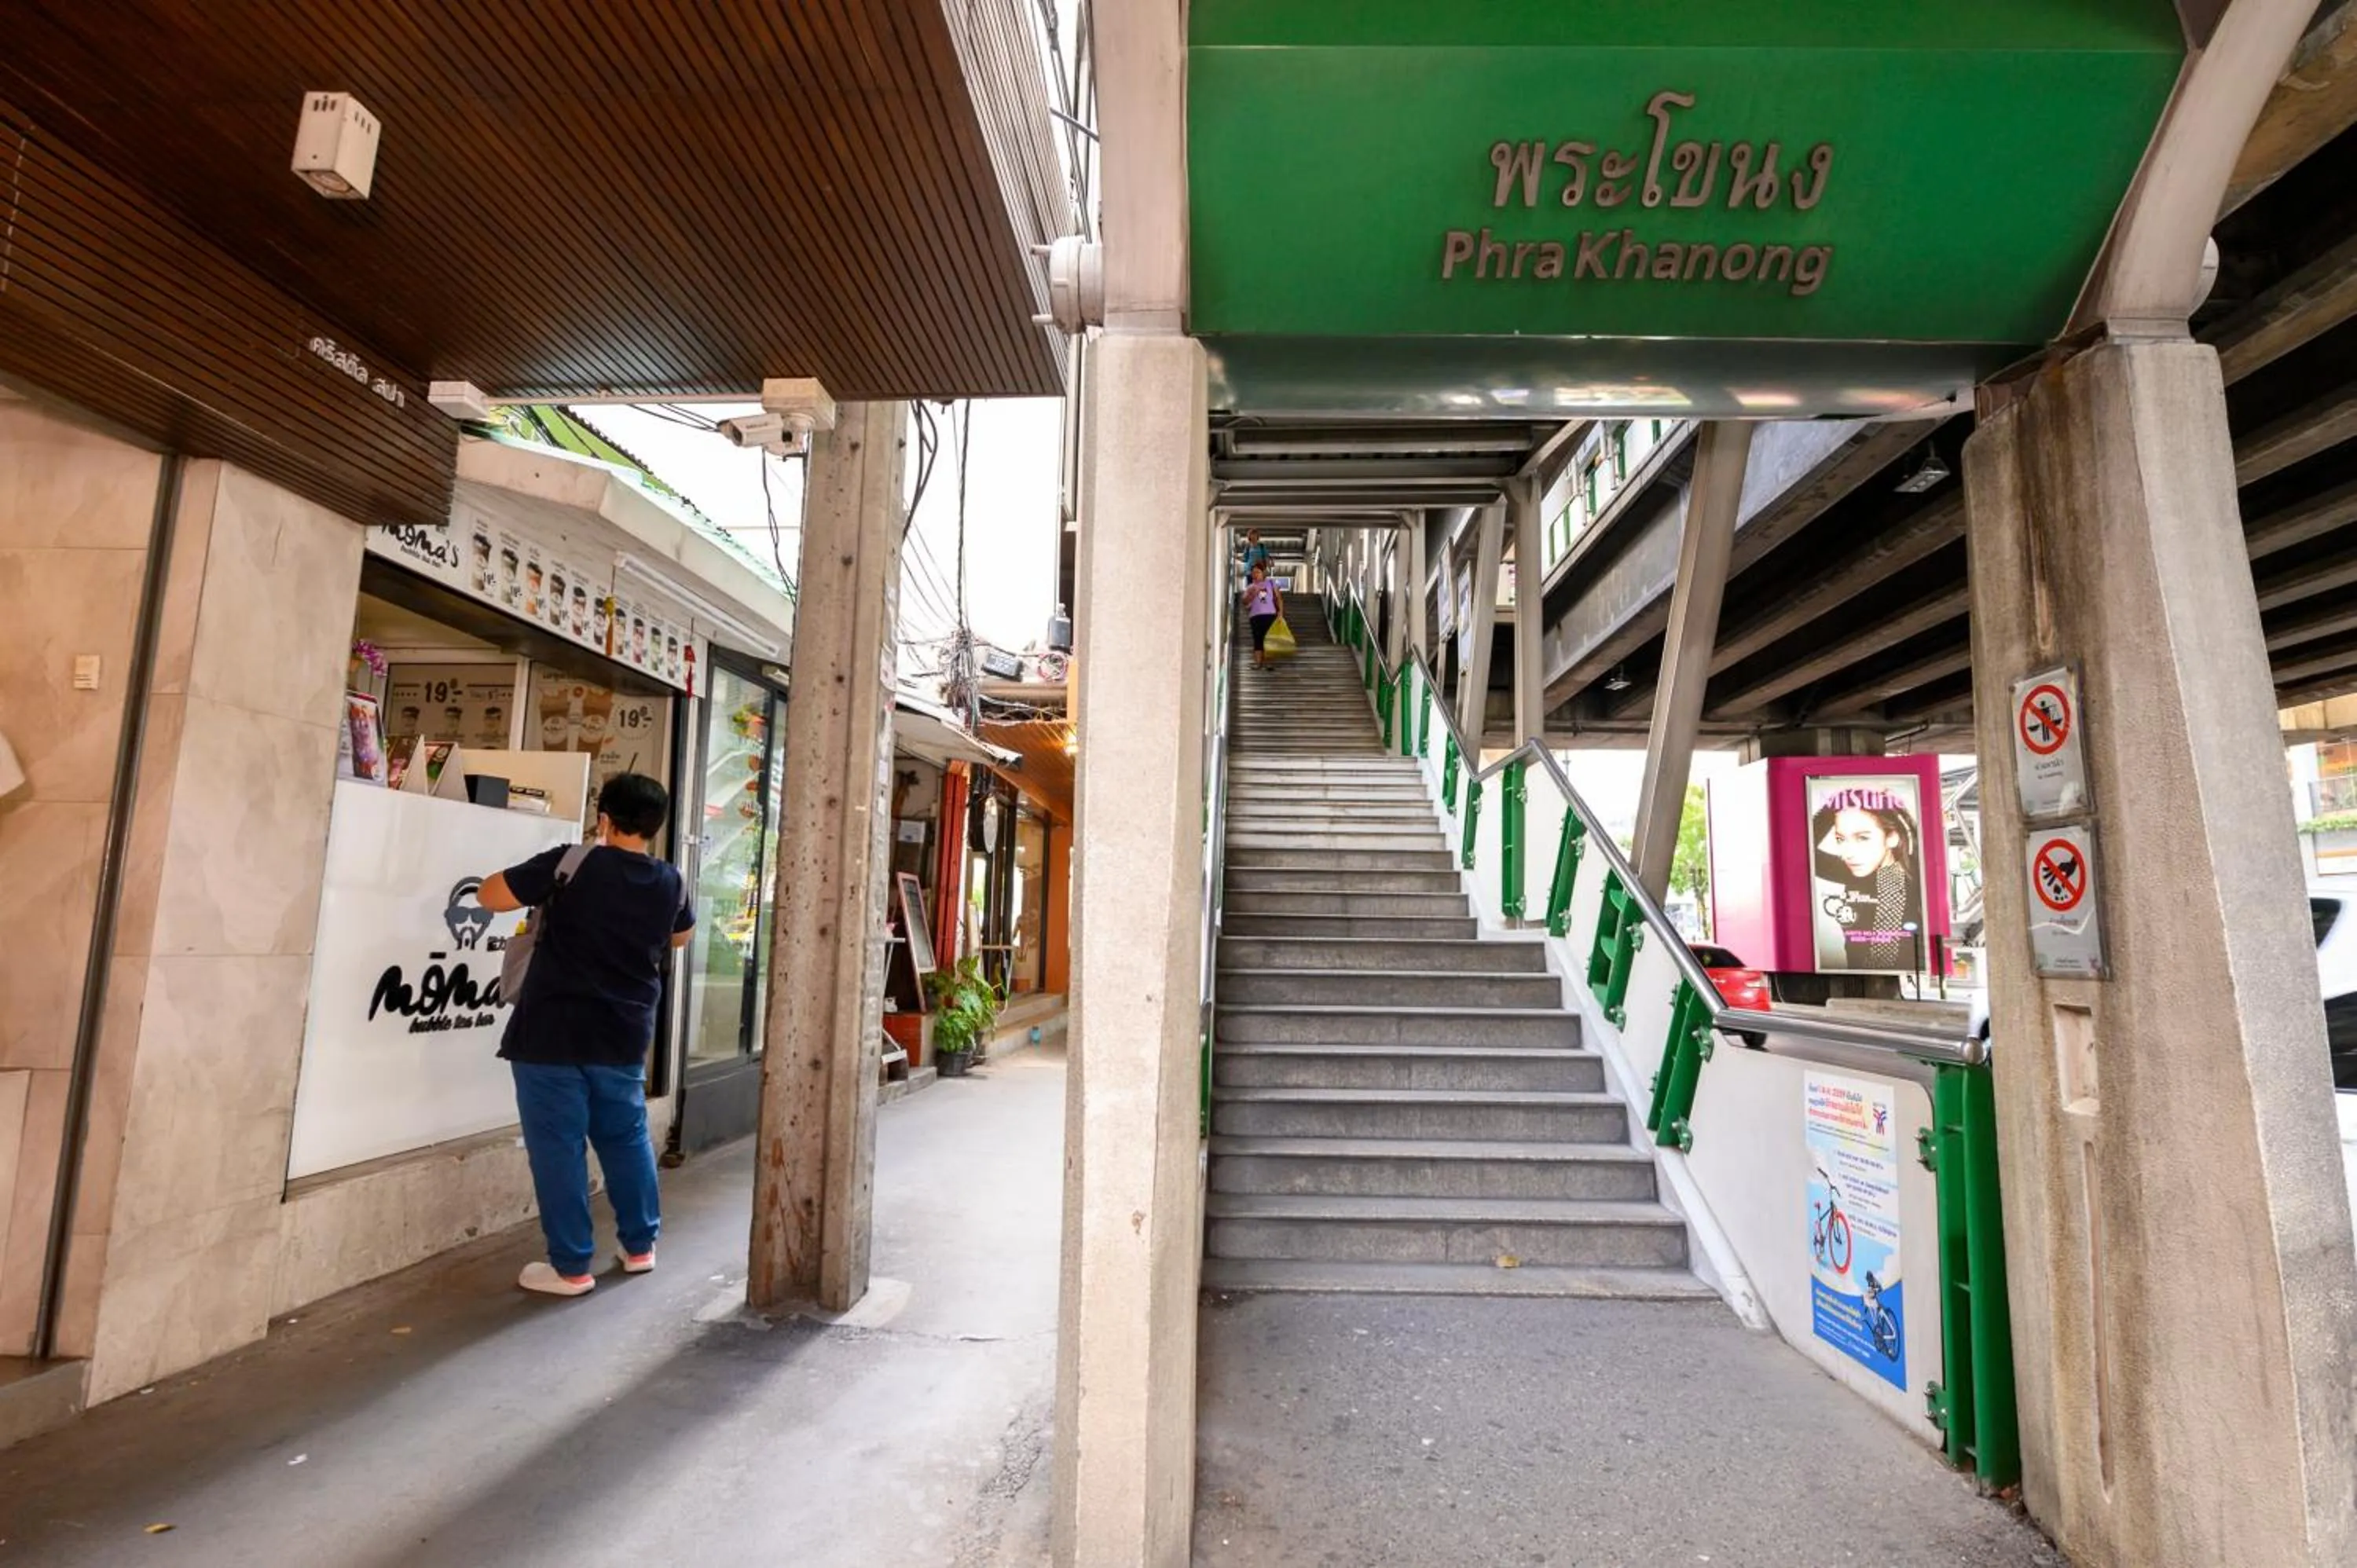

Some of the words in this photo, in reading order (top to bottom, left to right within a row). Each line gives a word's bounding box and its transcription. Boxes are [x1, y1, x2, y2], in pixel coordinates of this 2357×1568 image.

[1490, 90, 1834, 210] พระโขนง
[1441, 228, 1566, 280] Phra
[1573, 229, 1834, 296] Khanong
